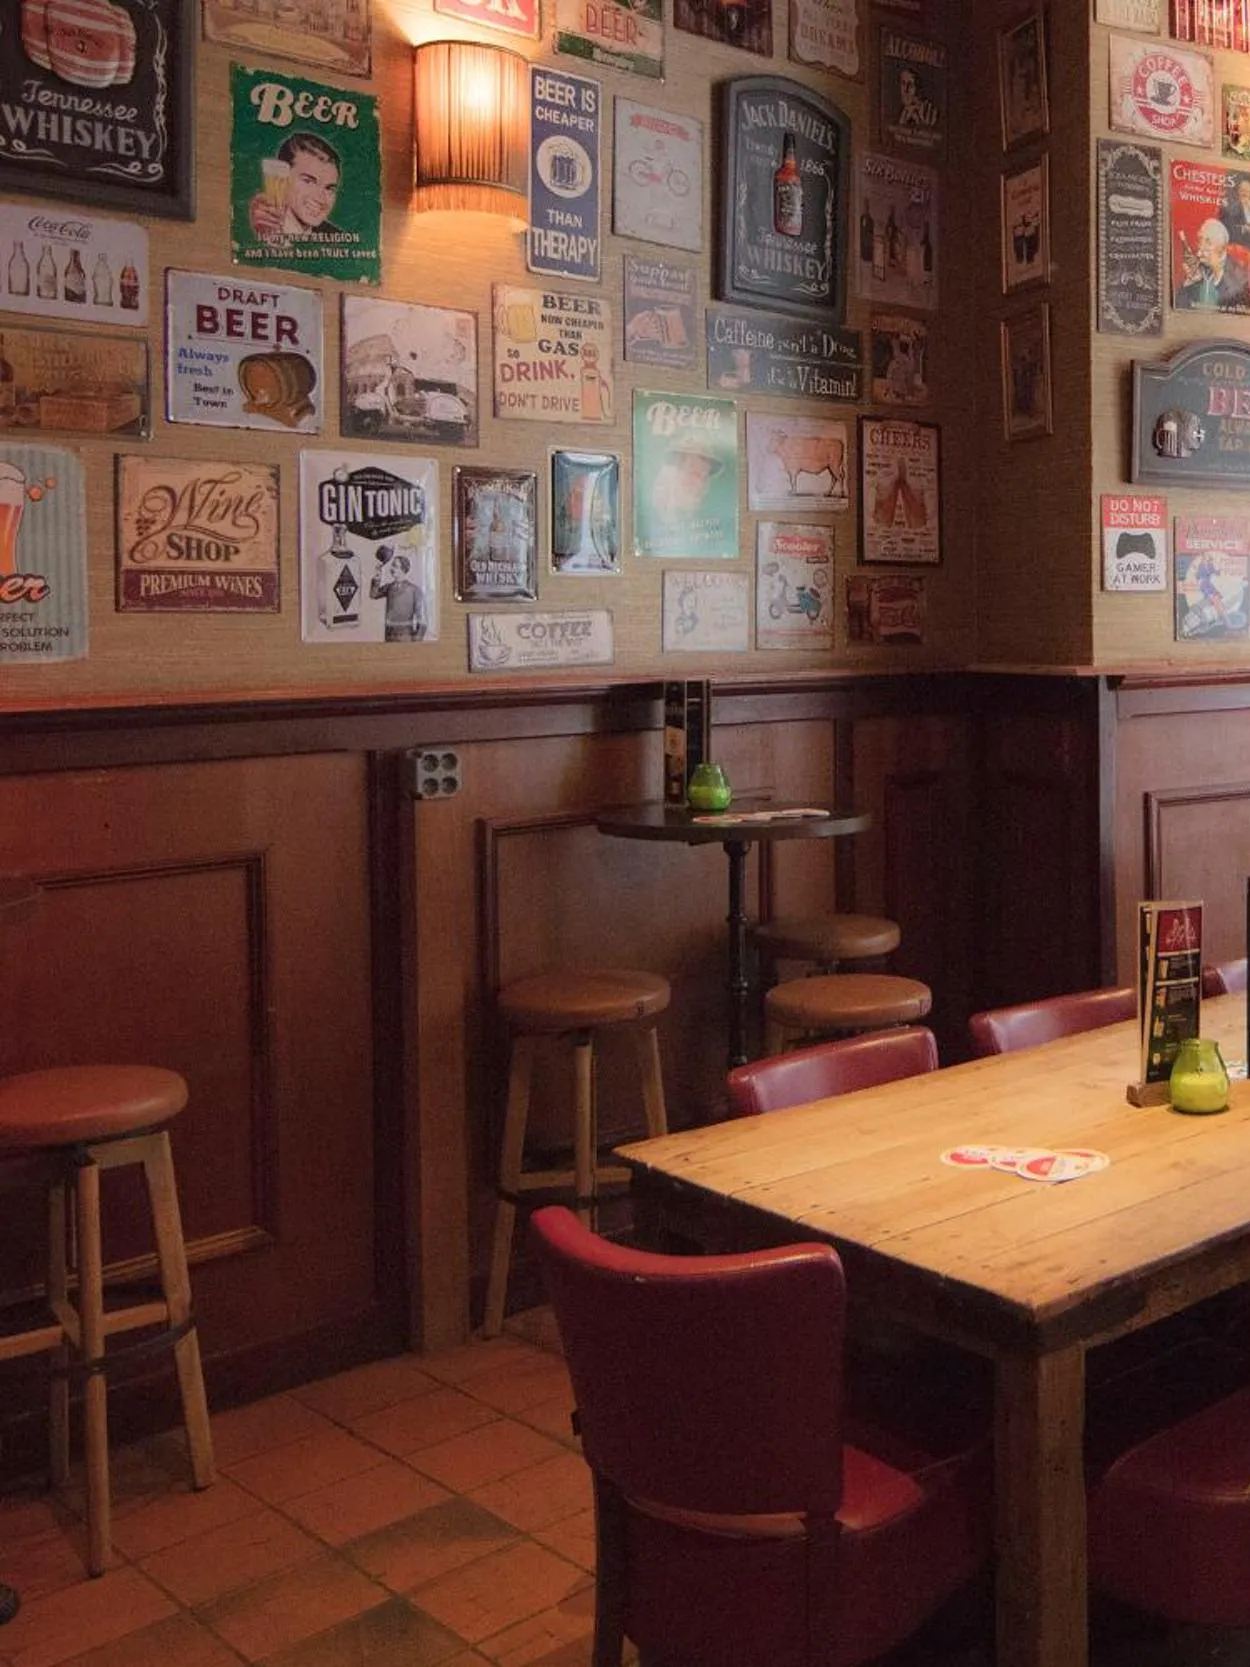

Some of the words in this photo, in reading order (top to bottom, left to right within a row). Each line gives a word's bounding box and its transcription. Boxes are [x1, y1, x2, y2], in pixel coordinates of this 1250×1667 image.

[1138, 56, 1188, 86] COFFEE
[21, 79, 138, 123] Tennessee
[535, 76, 576, 108] BEER
[581, 88, 596, 113] IS
[535, 105, 595, 132] CHEAPER
[742, 100, 778, 130] JACK
[1, 103, 157, 159] WHISKEY
[546, 209, 583, 229] THAN
[311, 232, 360, 243] RELIGION
[532, 227, 598, 267] THERAPY
[747, 244, 826, 281] WHISKEY
[217, 287, 280, 308] DRAFT
[541, 293, 602, 316] BEER
[196, 303, 299, 346] BEER
[540, 313, 562, 325] NOW
[559, 329, 583, 341] THAN
[714, 318, 775, 350] Caffeine
[178, 347, 230, 364] Always
[538, 338, 580, 357] GAS
[176, 364, 213, 377] fresh
[1203, 362, 1246, 381] COLD
[193, 396, 228, 409] Town
[499, 390, 537, 408] DON'T
[542, 395, 581, 412] DRIVE
[869, 427, 931, 452] CHEERS
[133, 472, 263, 545] Wine
[322, 483, 364, 523] GIN
[365, 488, 422, 519] TONIC
[1110, 499, 1129, 511] DO
[1133, 498, 1160, 512] NOT
[1110, 512, 1161, 525] DISTURB
[166, 532, 241, 562] SHOP
[1116, 562, 1156, 573] GAMER
[139, 574, 211, 597] PREMIUM
[215, 574, 264, 598] WINES
[1113, 574, 1127, 584] AT
[1131, 573, 1161, 585] WORK
[2, 626, 70, 638] SOLUTION
